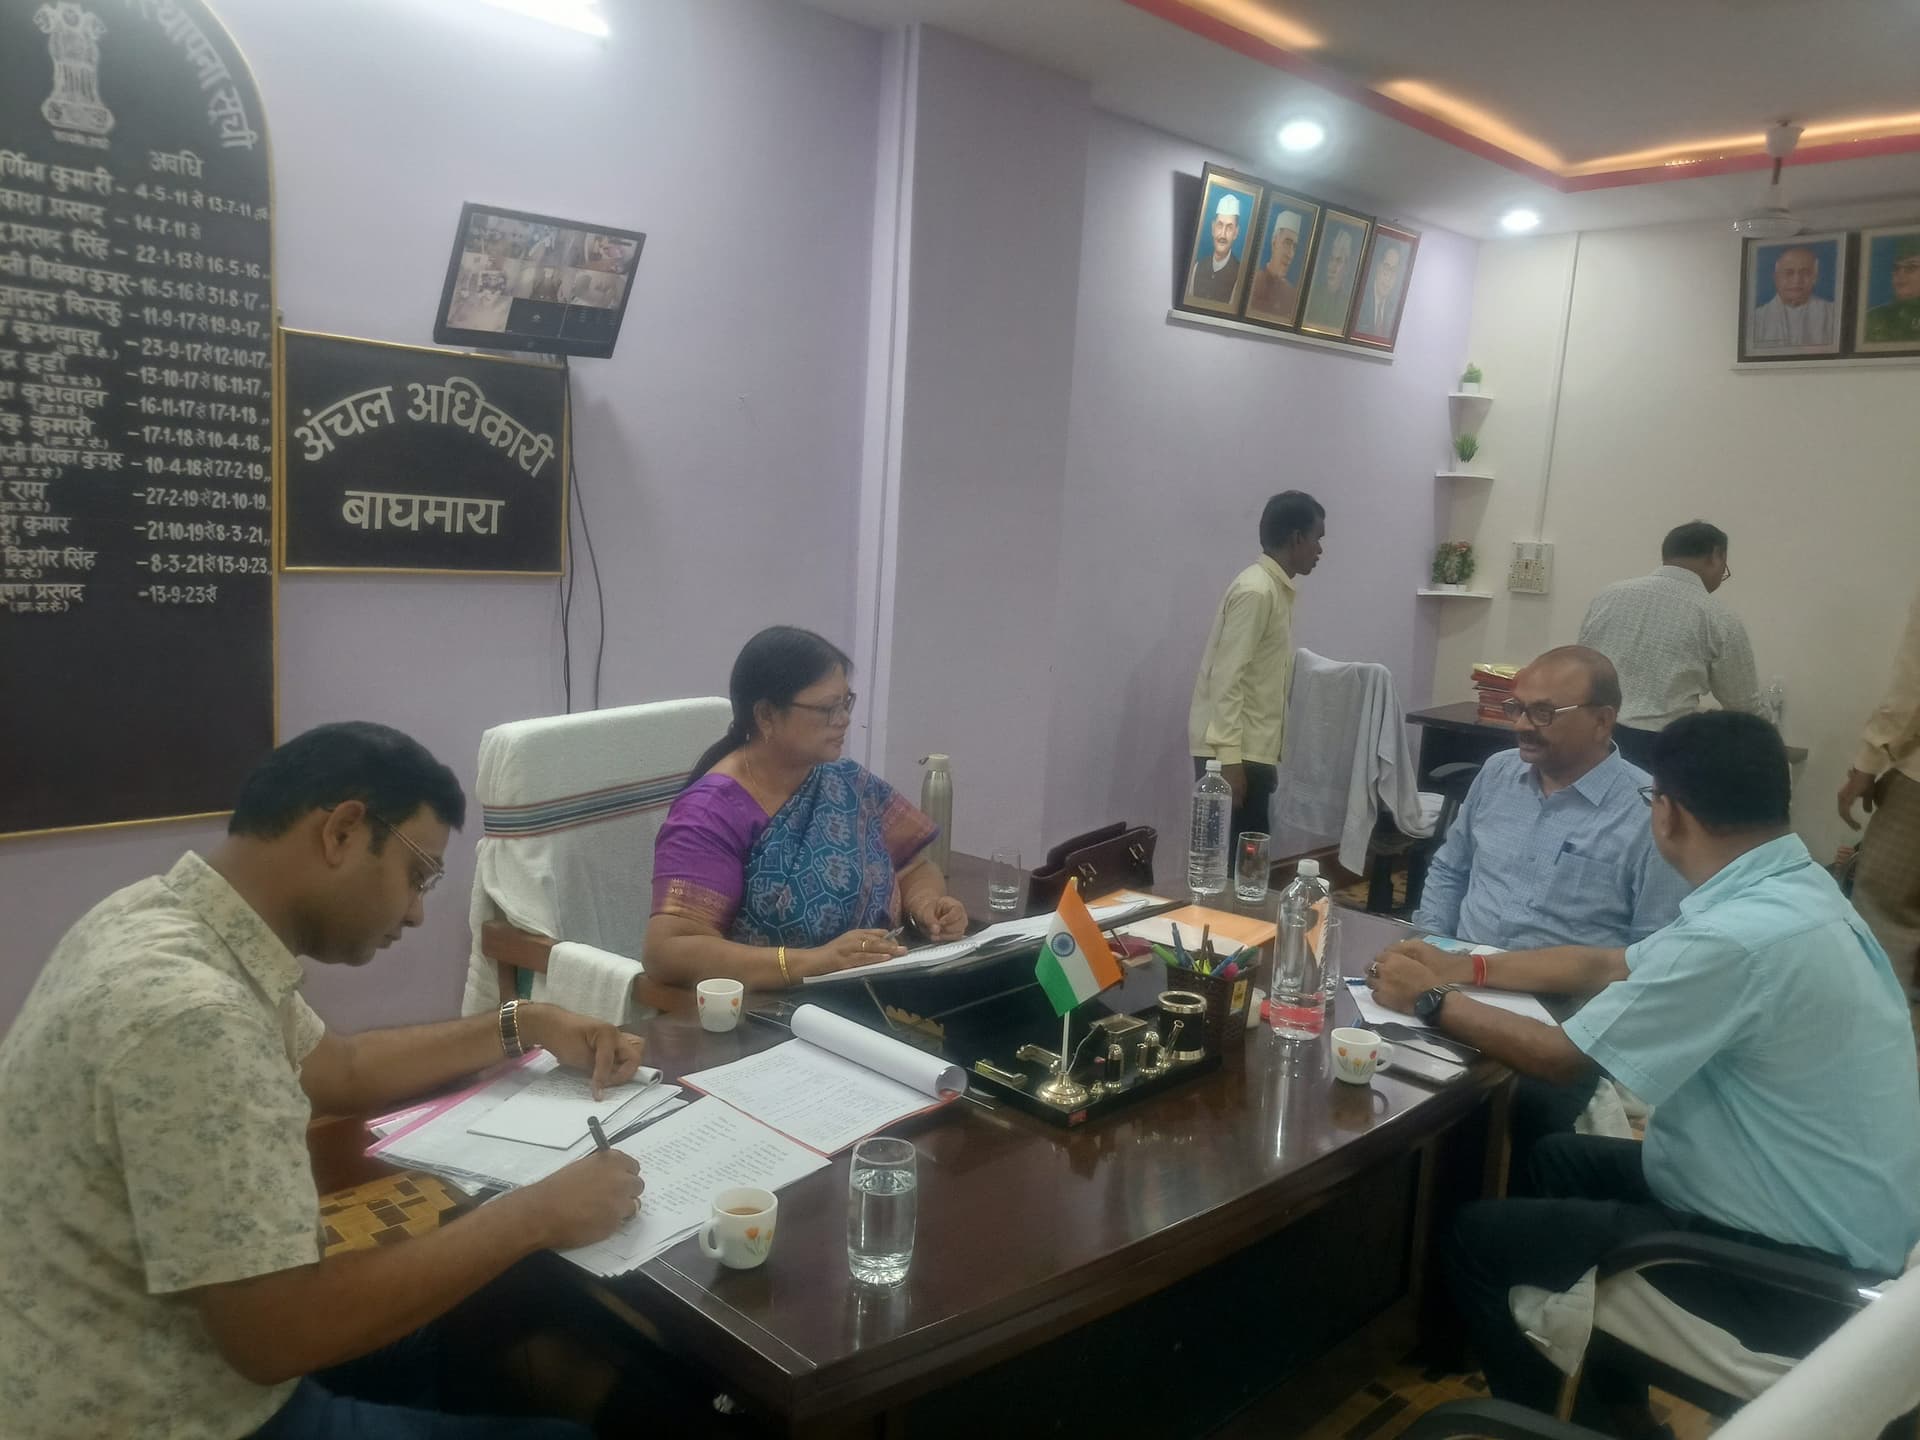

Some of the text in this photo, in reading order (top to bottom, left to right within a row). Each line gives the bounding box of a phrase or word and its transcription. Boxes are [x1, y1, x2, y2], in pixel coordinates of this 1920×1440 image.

[150, 149, 206, 180] अवधि
[50, 165, 115, 195] कुमारी
[48, 196, 107, 229] प्रसाद
[70, 228, 111, 261] सिंह
[12, 320, 102, 348] कुशवाहा
[21, 383, 110, 408] कुशवाहा
[30, 416, 96, 437] कुमारी
[294, 377, 554, 477] अंचल अधिकारी
[81, 451, 125, 471] कुजूर
[9, 481, 50, 501] राम
[342, 491, 505, 534] बाघमारा
[23, 516, 72, 536] कुमार
[4, 546, 60, 568] किशोर
[63, 547, 98, 571] सिंह
[34, 584, 86, 602] प्रसाद
